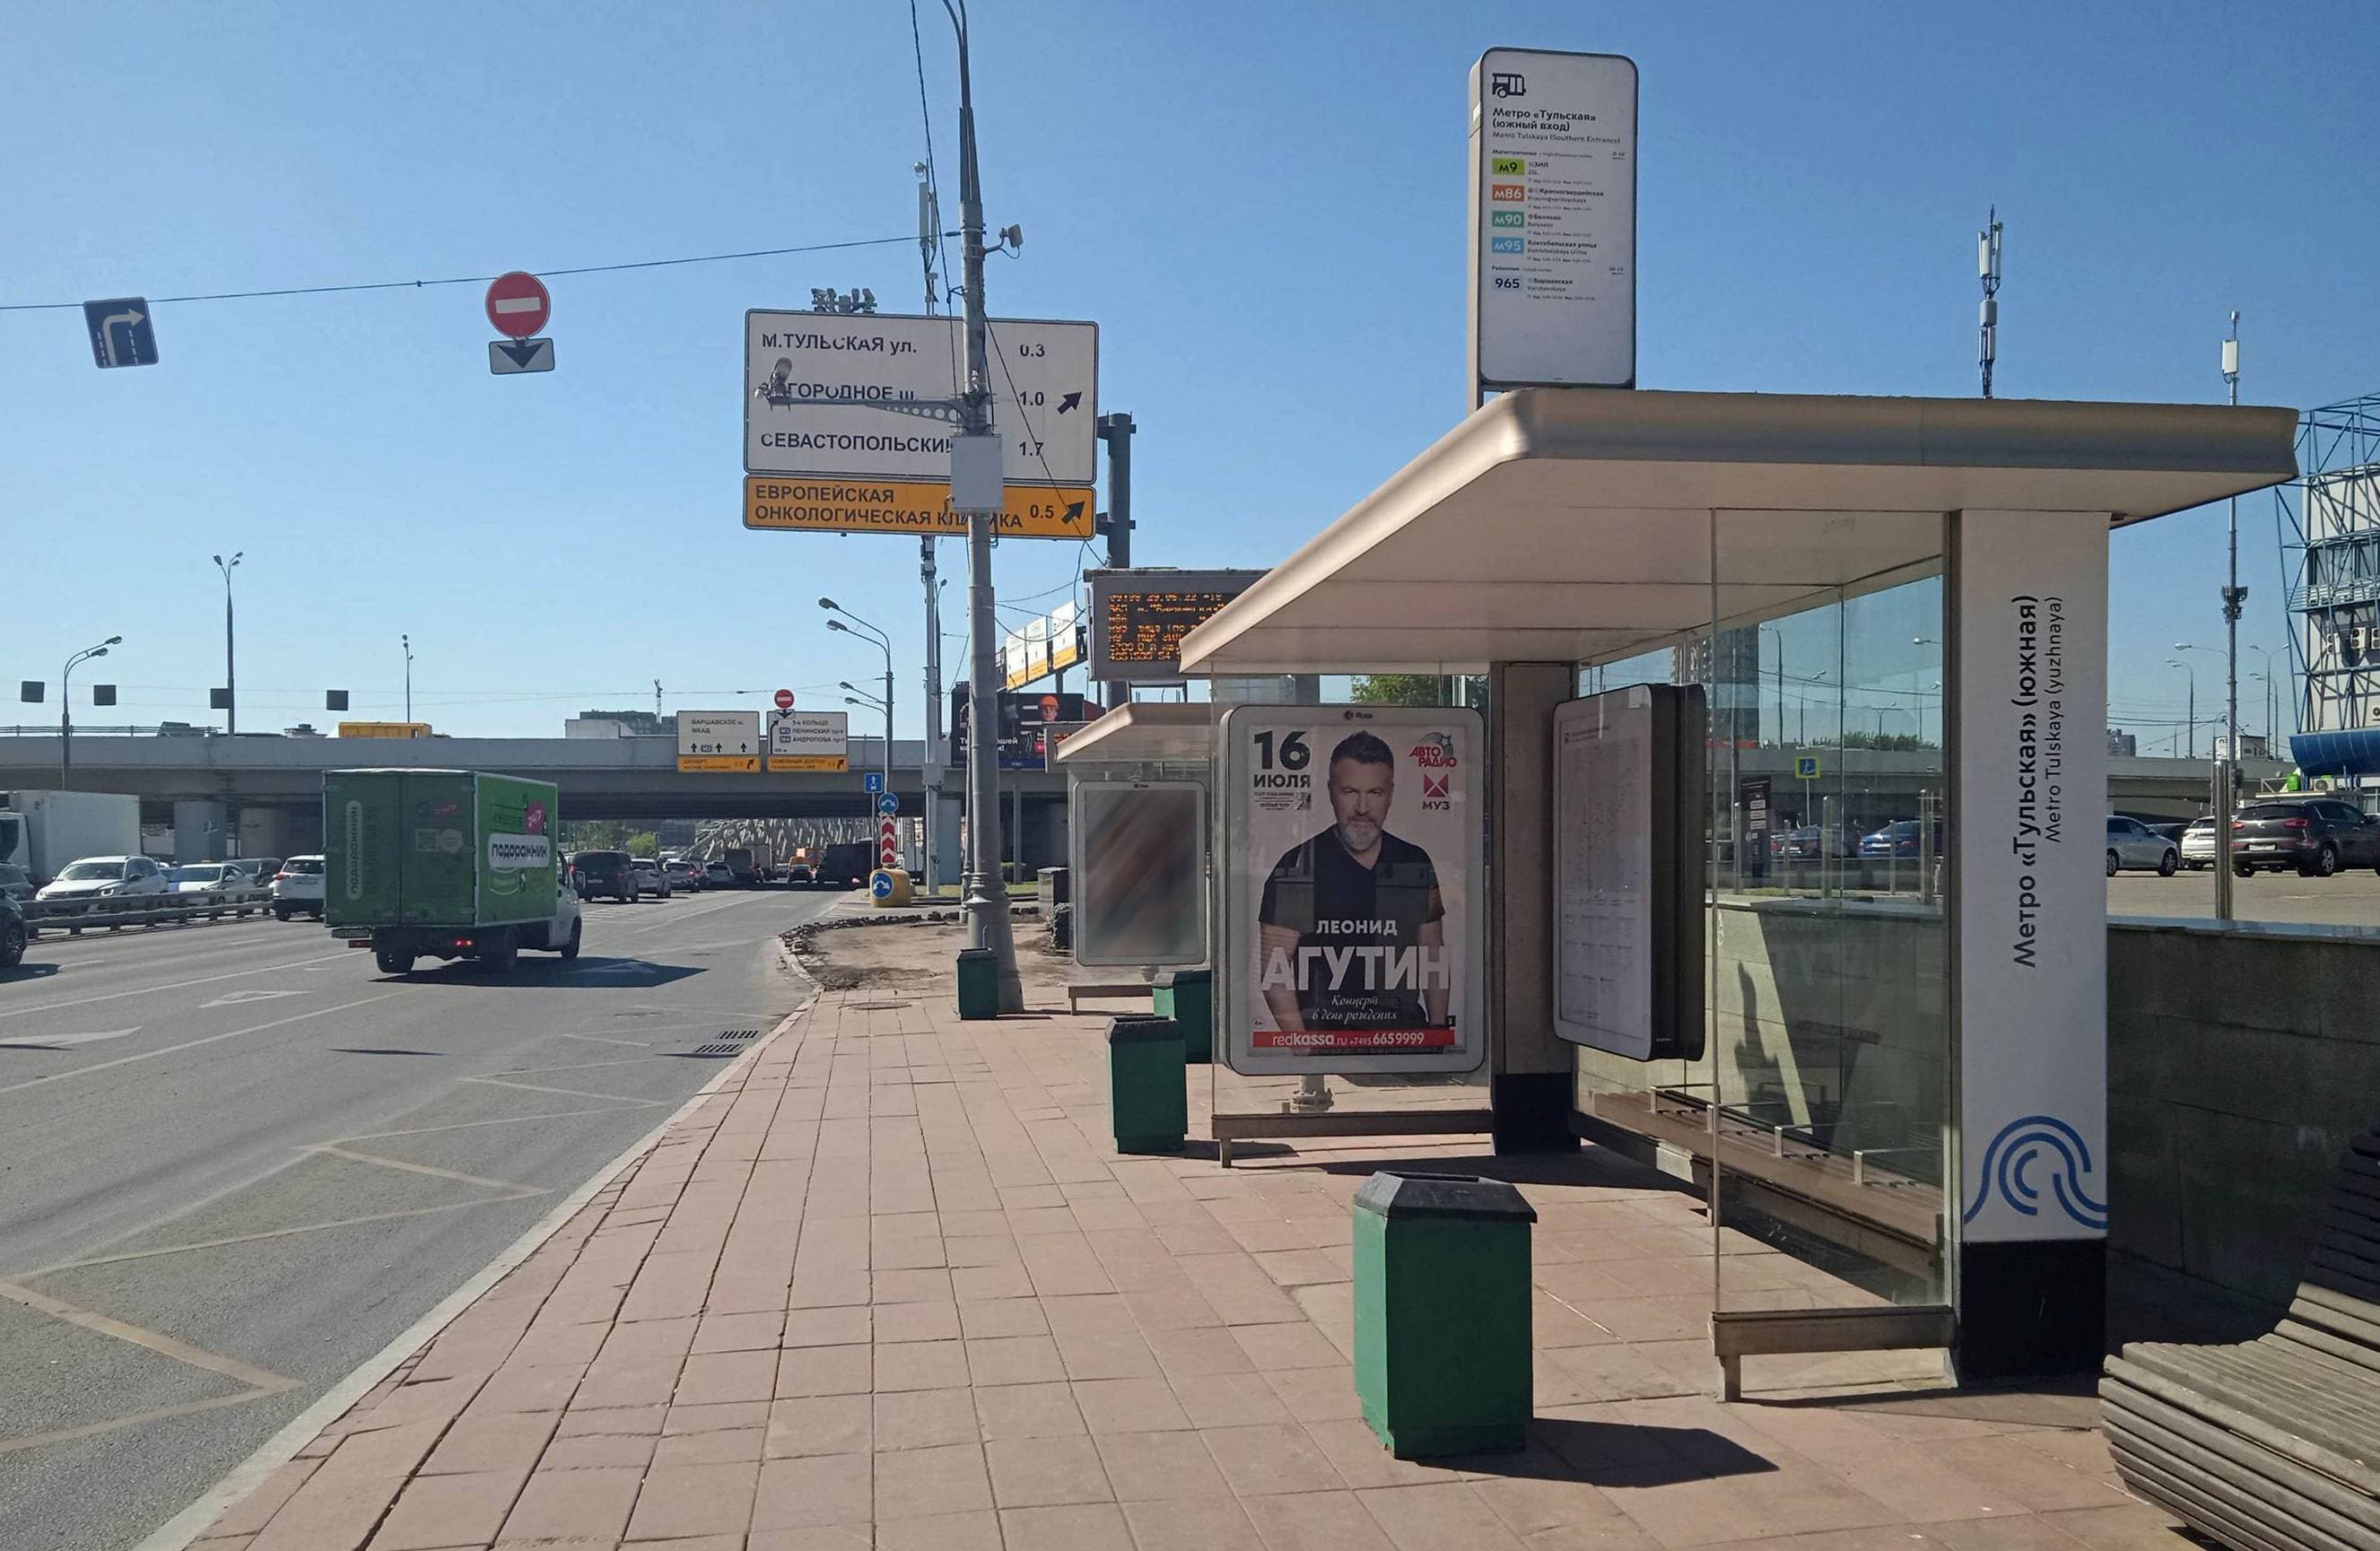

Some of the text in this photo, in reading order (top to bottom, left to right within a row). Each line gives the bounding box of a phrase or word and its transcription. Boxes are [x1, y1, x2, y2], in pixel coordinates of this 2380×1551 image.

[1492, 108, 1597, 122] Метро «Тульская»
[1492, 118, 1570, 132] (южный вход)
[1517, 132, 1548, 141] Tulskaya
[1549, 134, 1584, 142] (Southern
[1586, 135, 1621, 144] Entrance)
[1495, 278, 1520, 288] 965
[762, 333, 918, 355] М.ТУЛЬСКАЯ ул.
[1019, 344, 1045, 358] 0.3
[762, 381, 894, 400] ГОРОДНОЕ
[1019, 391, 1045, 406] 1.0
[1018, 441, 1044, 457] 1.7
[755, 484, 894, 503] ЕВРОПЕЙСКАЯ
[754, 505, 1023, 528] ОНКОЛОГИЧЕСКАЯ КЛИКА
[1029, 504, 1054, 519] 0.5
[2044, 596, 2064, 842] Metro Tulskaya (yuzhnaya)
[1253, 730, 1311, 771] 16
[1408, 746, 1441, 757] АВТО
[1418, 757, 1458, 768] РАДИО
[1253, 774, 1311, 788] ИЮЛЯ
[2011, 595, 2042, 968] Метро «Тульская» (южная)
[1422, 800, 1451, 810] МУЗ
[1316, 919, 1399, 936] ЛЕОНИД
[1261, 945, 1451, 990] АГУТИН
[1331, 994, 1379, 1010] Концерт
[1321, 1009, 1344, 1021] день
[1344, 1010, 1398, 1025] рождения
[1272, 1033, 1347, 1046] redkassa.ru
[1373, 1033, 1425, 1045] 6659999
